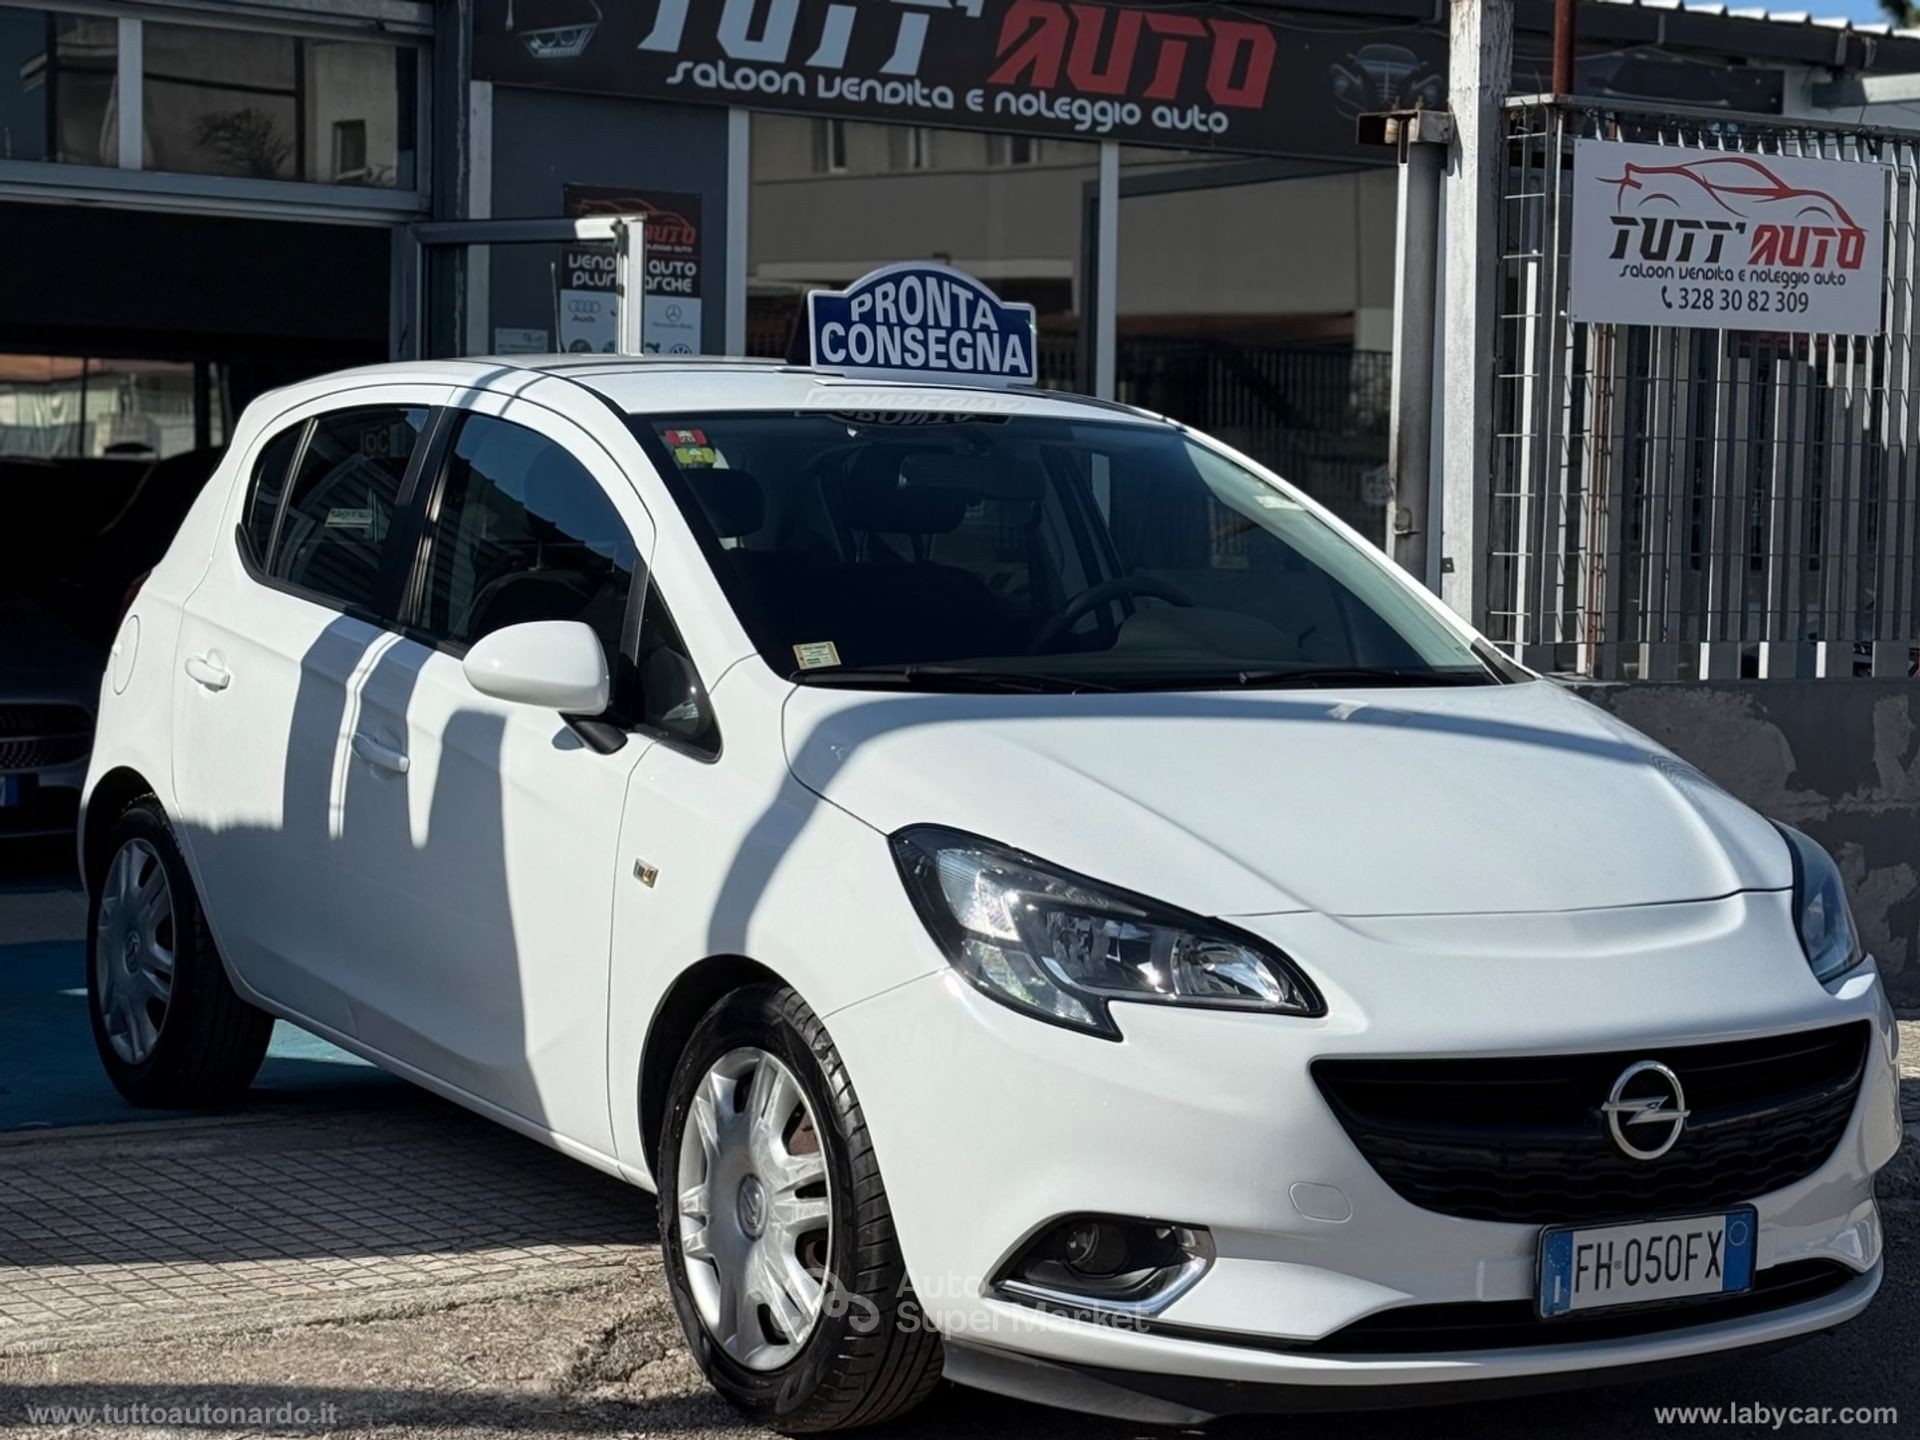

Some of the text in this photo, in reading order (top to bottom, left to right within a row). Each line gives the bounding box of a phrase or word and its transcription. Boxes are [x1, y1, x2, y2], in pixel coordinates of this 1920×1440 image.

[986, 1, 1278, 109] AUTO
[666, 59, 806, 96] saloon
[817, 74, 954, 110] vendita
[994, 90, 1142, 132] noleggio
[1151, 104, 1229, 133] auto
[649, 259, 697, 276] AUTO
[1608, 216, 1866, 270] TUTT' AUTO
[1619, 263, 1674, 279] saloon
[1679, 265, 1734, 282] vendita
[1750, 269, 1809, 289] noleggio
[1814, 270, 1846, 286] auto
[1678, 287, 1809, 313] 328 30 82 309
[851, 275, 999, 331] PRONTA
[821, 322, 1029, 374] CONSEGNA
